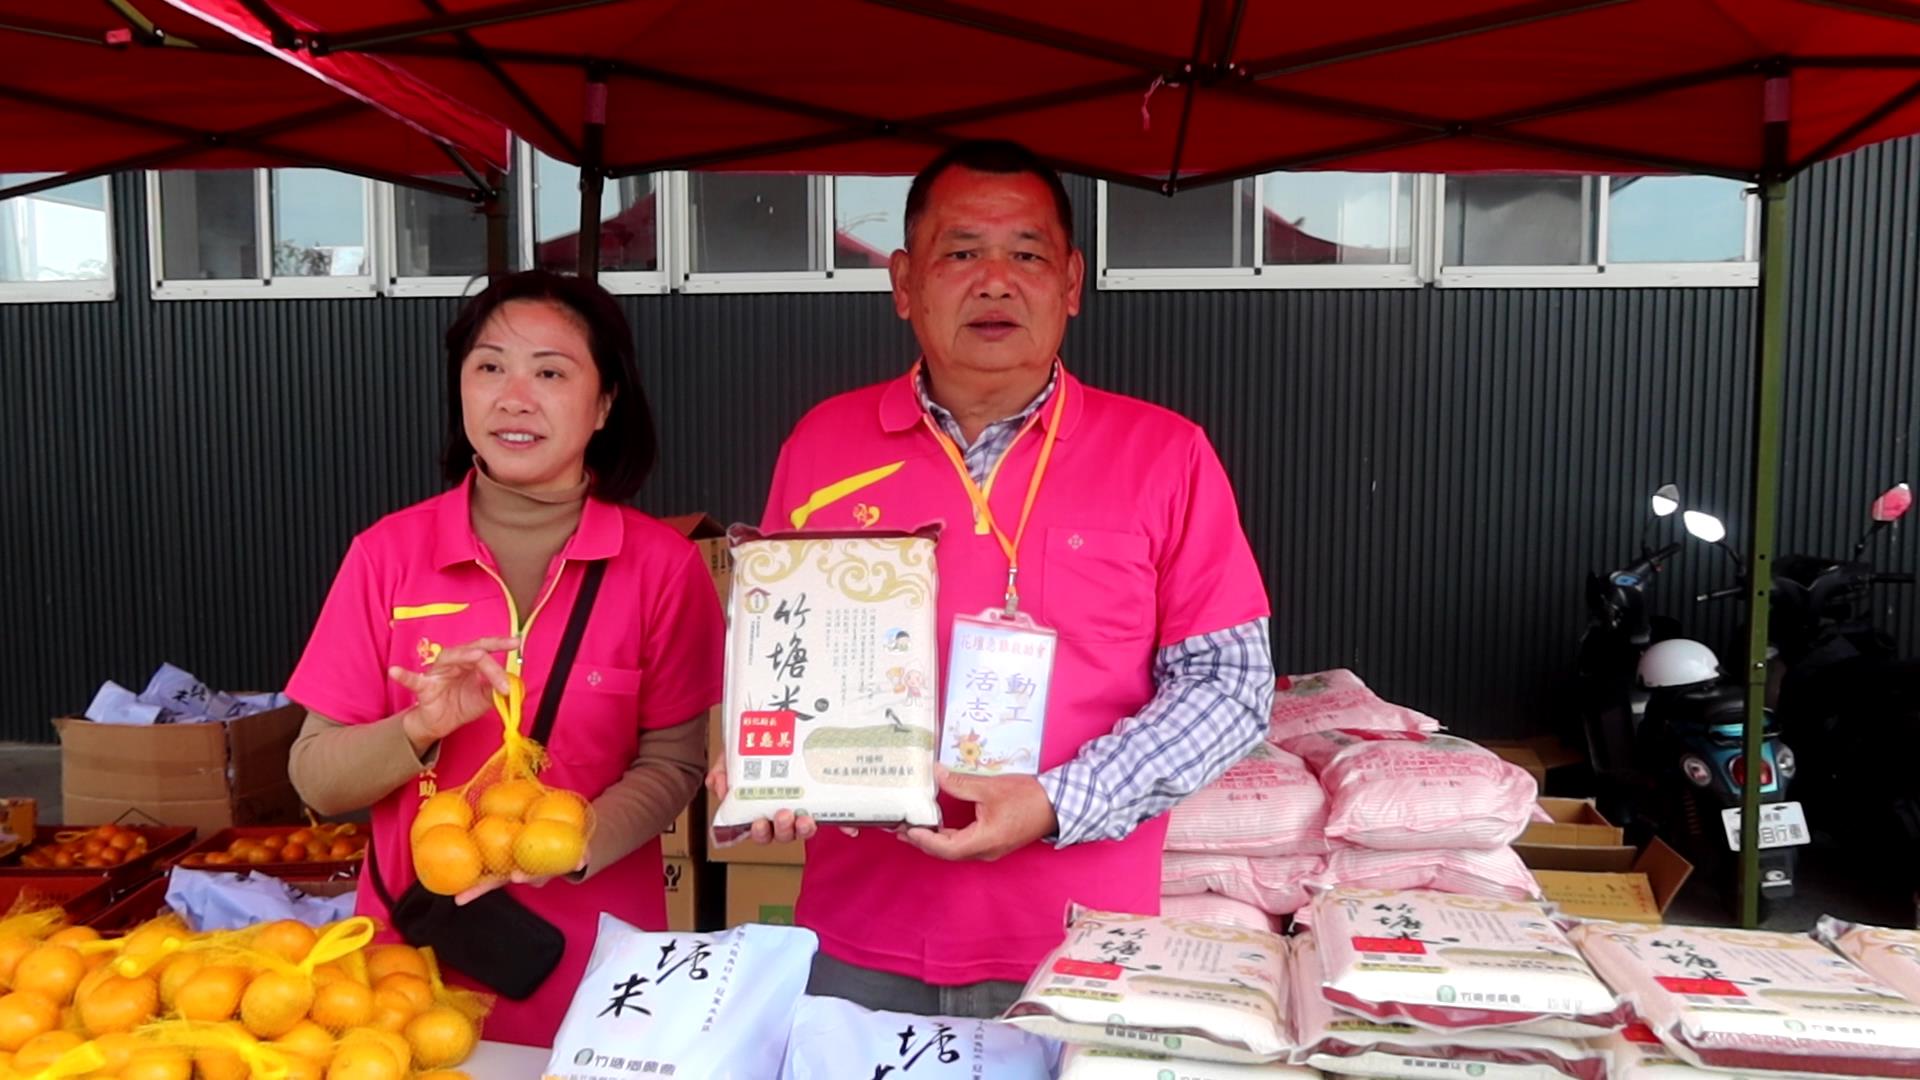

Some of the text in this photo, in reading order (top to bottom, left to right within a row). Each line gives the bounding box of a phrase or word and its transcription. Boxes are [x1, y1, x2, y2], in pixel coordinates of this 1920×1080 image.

[766, 592, 815, 721] 竹塘米
[966, 668, 1037, 698] 活動
[962, 697, 1033, 724] 志工
